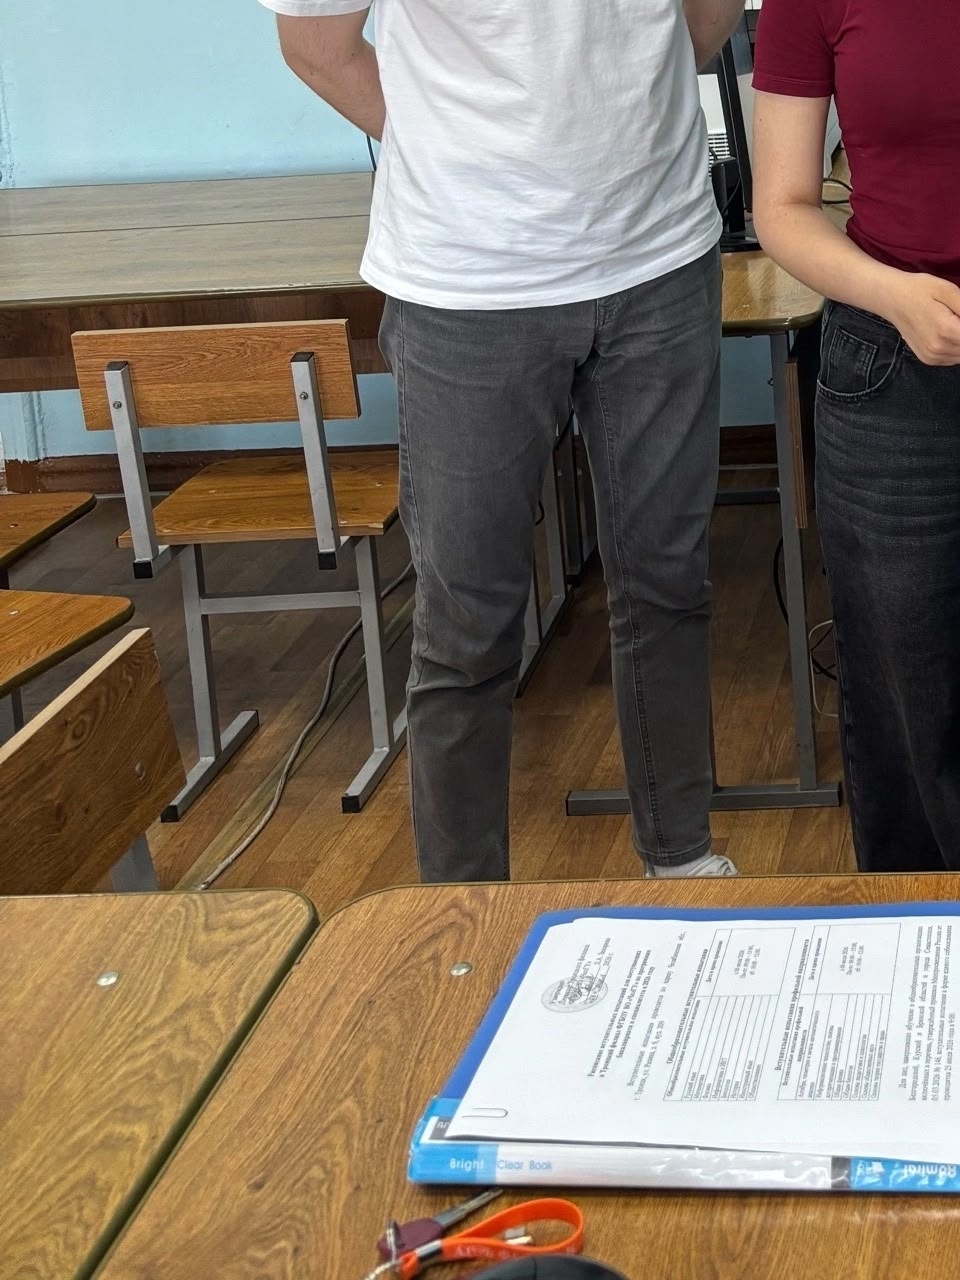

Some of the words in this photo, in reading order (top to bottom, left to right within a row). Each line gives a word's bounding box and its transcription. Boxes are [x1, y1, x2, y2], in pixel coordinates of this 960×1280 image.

[774, 1031, 791, 1070] Вступительные
[449, 1158, 485, 1172] Bright
[497, 1159, 523, 1170] Clear
[529, 1160, 553, 1170] Book
